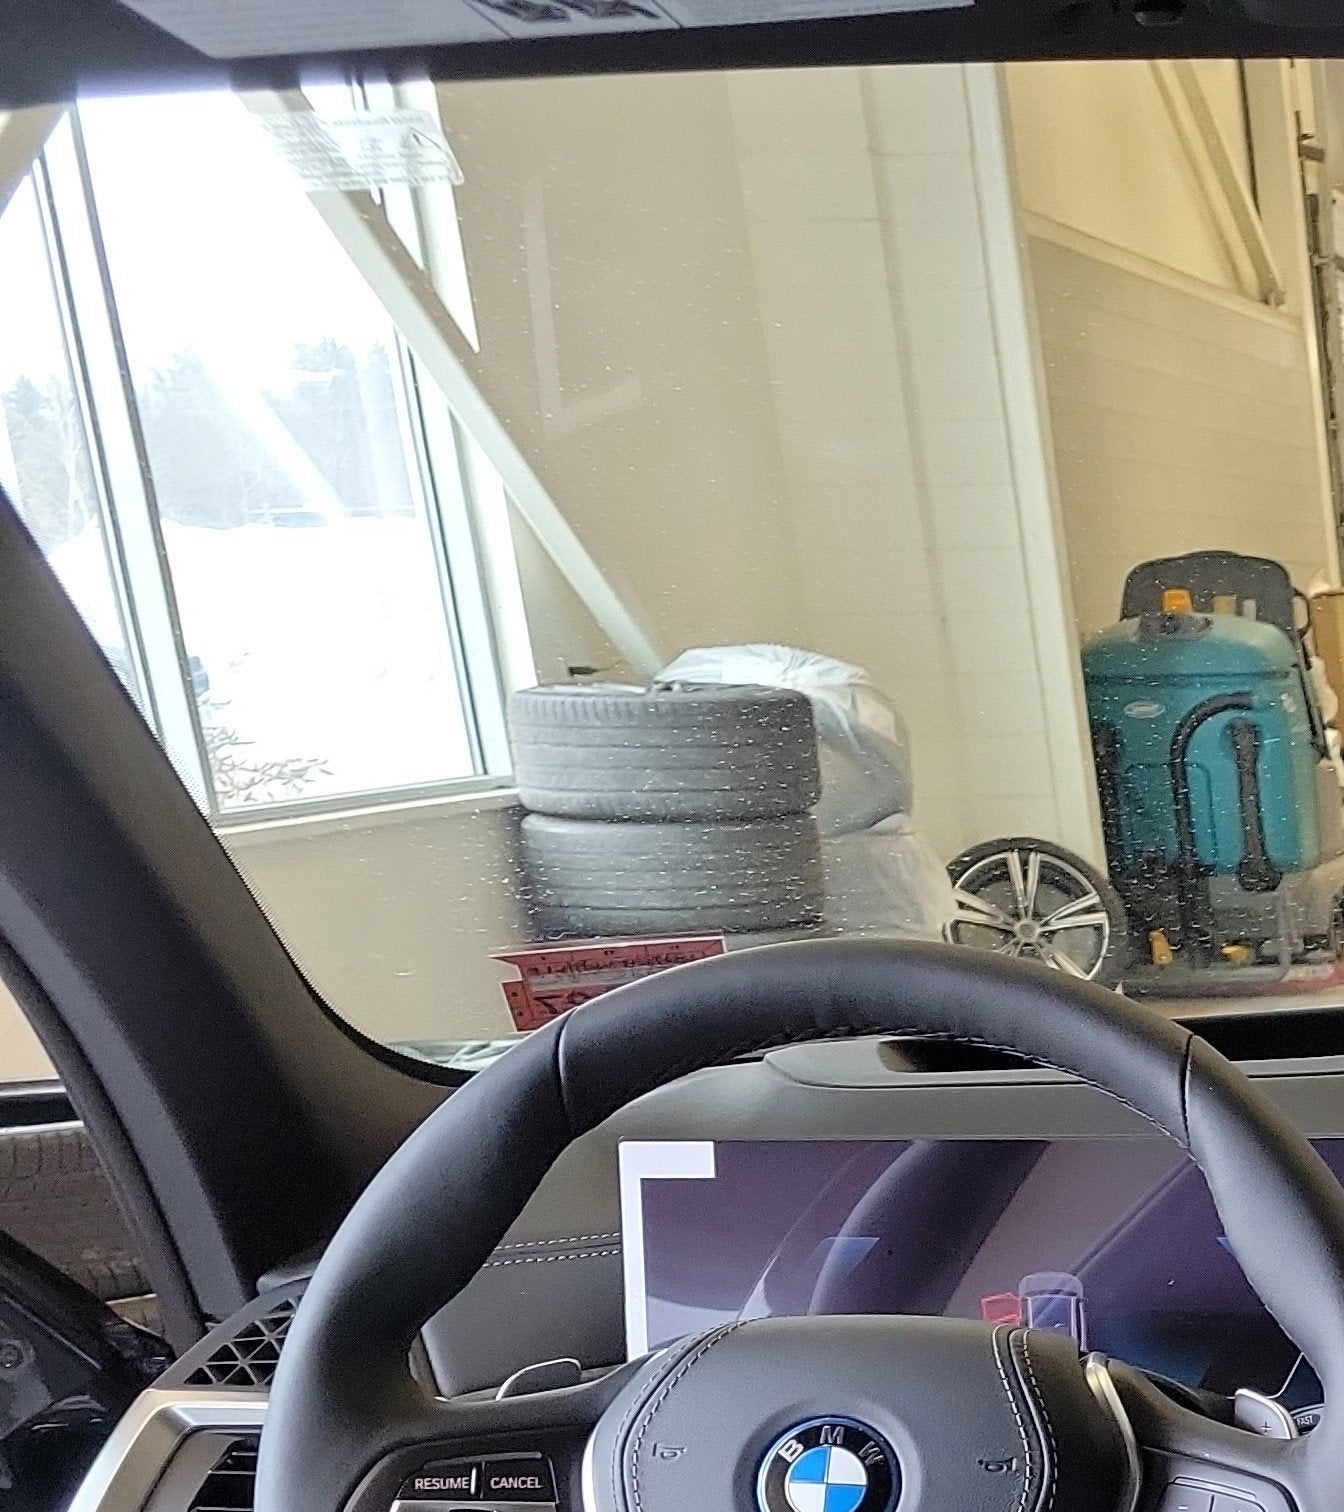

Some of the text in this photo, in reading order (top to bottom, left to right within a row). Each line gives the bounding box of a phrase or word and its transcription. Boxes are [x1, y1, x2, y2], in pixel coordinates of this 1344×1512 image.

[778, 1425, 884, 1466] BMW
[414, 1477, 470, 1490] RESUME
[490, 1477, 543, 1489] CANCEL
